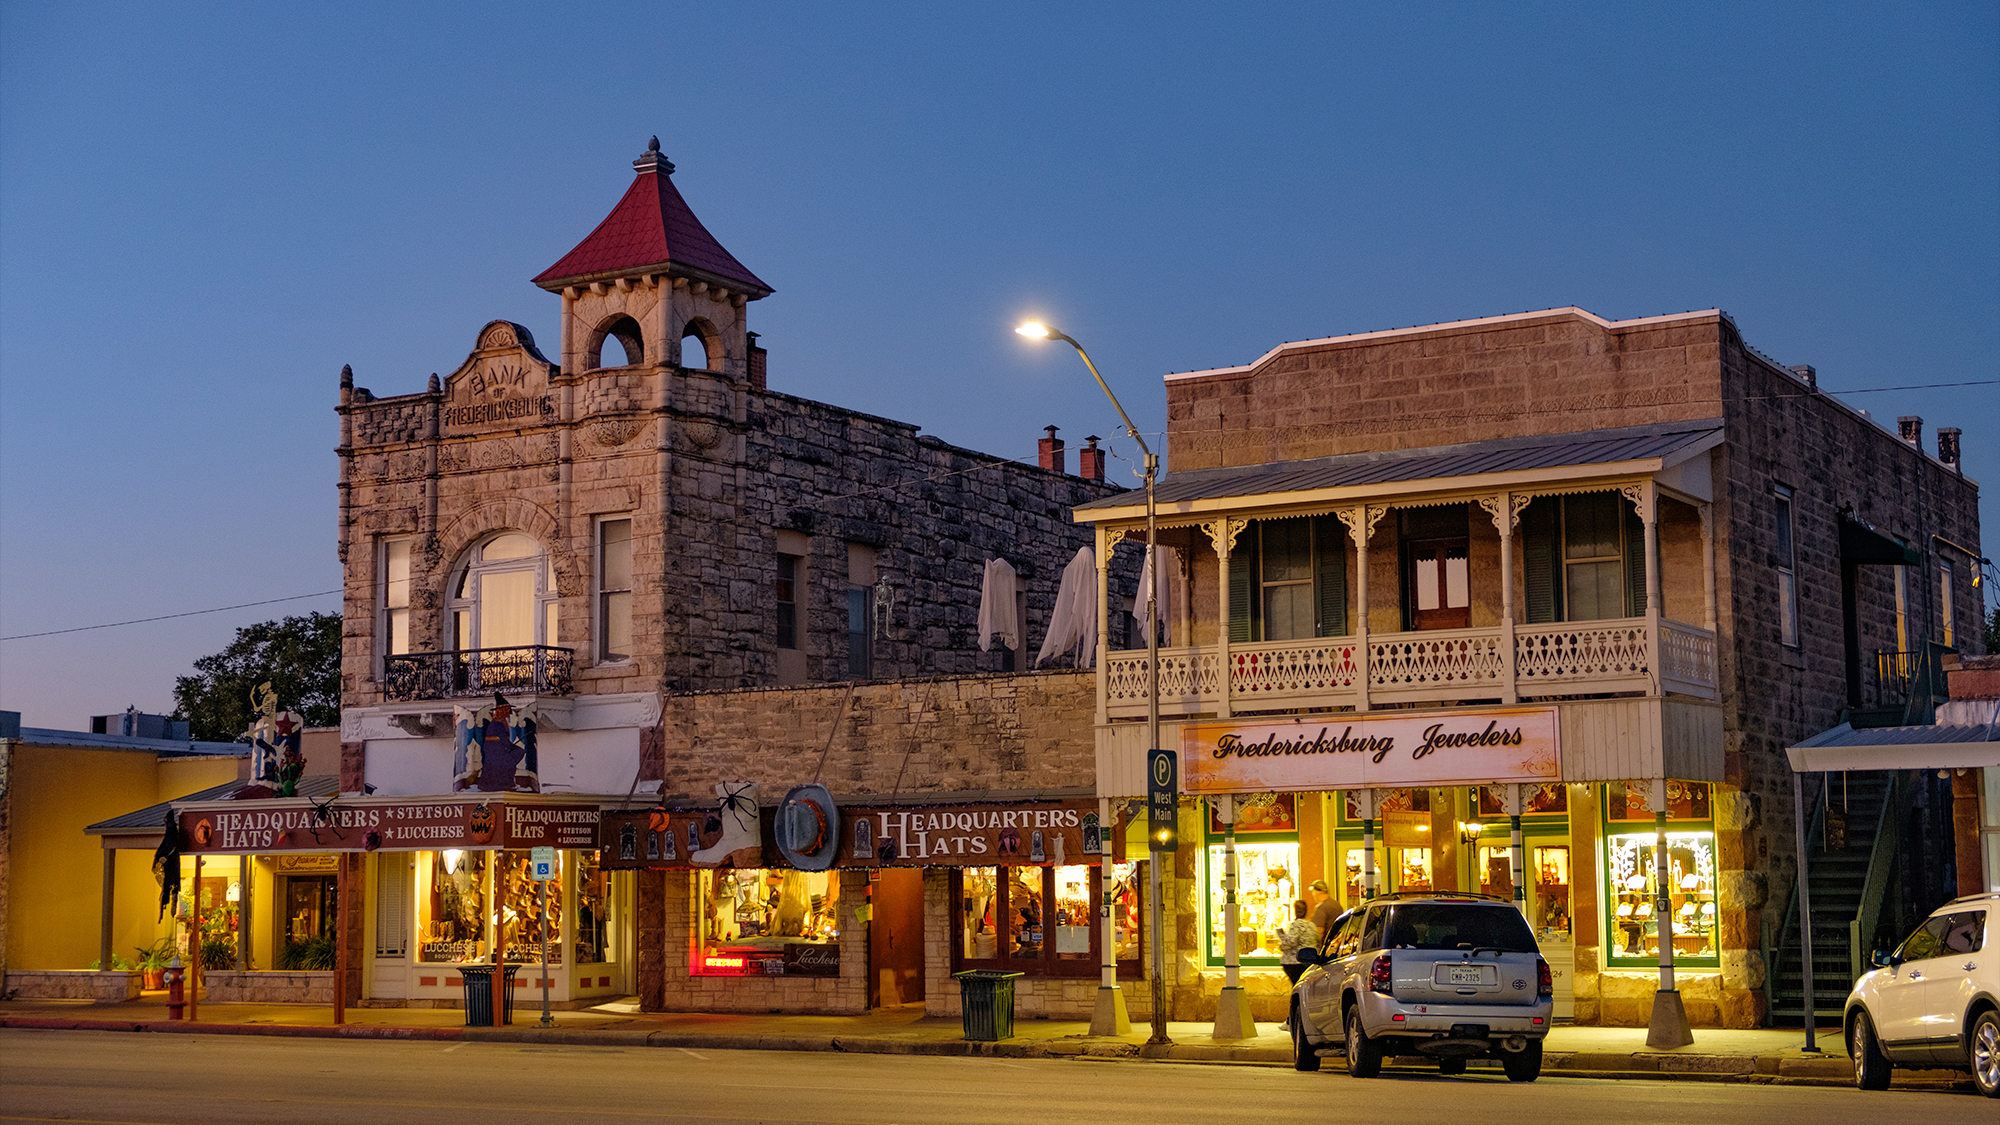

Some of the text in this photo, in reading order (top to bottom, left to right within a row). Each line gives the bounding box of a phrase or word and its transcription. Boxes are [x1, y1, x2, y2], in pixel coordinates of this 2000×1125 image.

[471, 364, 530, 396] BANK
[493, 387, 505, 399] OF
[445, 395, 553, 426] FREDERICKSBURG
[1212, 720, 1523, 764] Fredericksburg Jewelers
[1159, 760, 1167, 780] P
[1154, 791, 1172, 804] West
[215, 809, 380, 832] HEADQUARTERS
[397, 806, 464, 819] STETSON
[505, 806, 599, 824] HEADQUARTERS
[1154, 807, 1172, 821] Main
[397, 826, 464, 839] LUCCHESE
[511, 823, 545, 838] HATS
[877, 809, 1079, 839] HEADQUARTERS
[221, 830, 273, 848] HATS
[562, 836, 592, 844] LUCCHESE
[897, 832, 988, 858] HATS
[424, 943, 476, 953] LUCCHESE
[505, 943, 553, 953] UCCHESE
[789, 948, 840, 969] Lucchese
